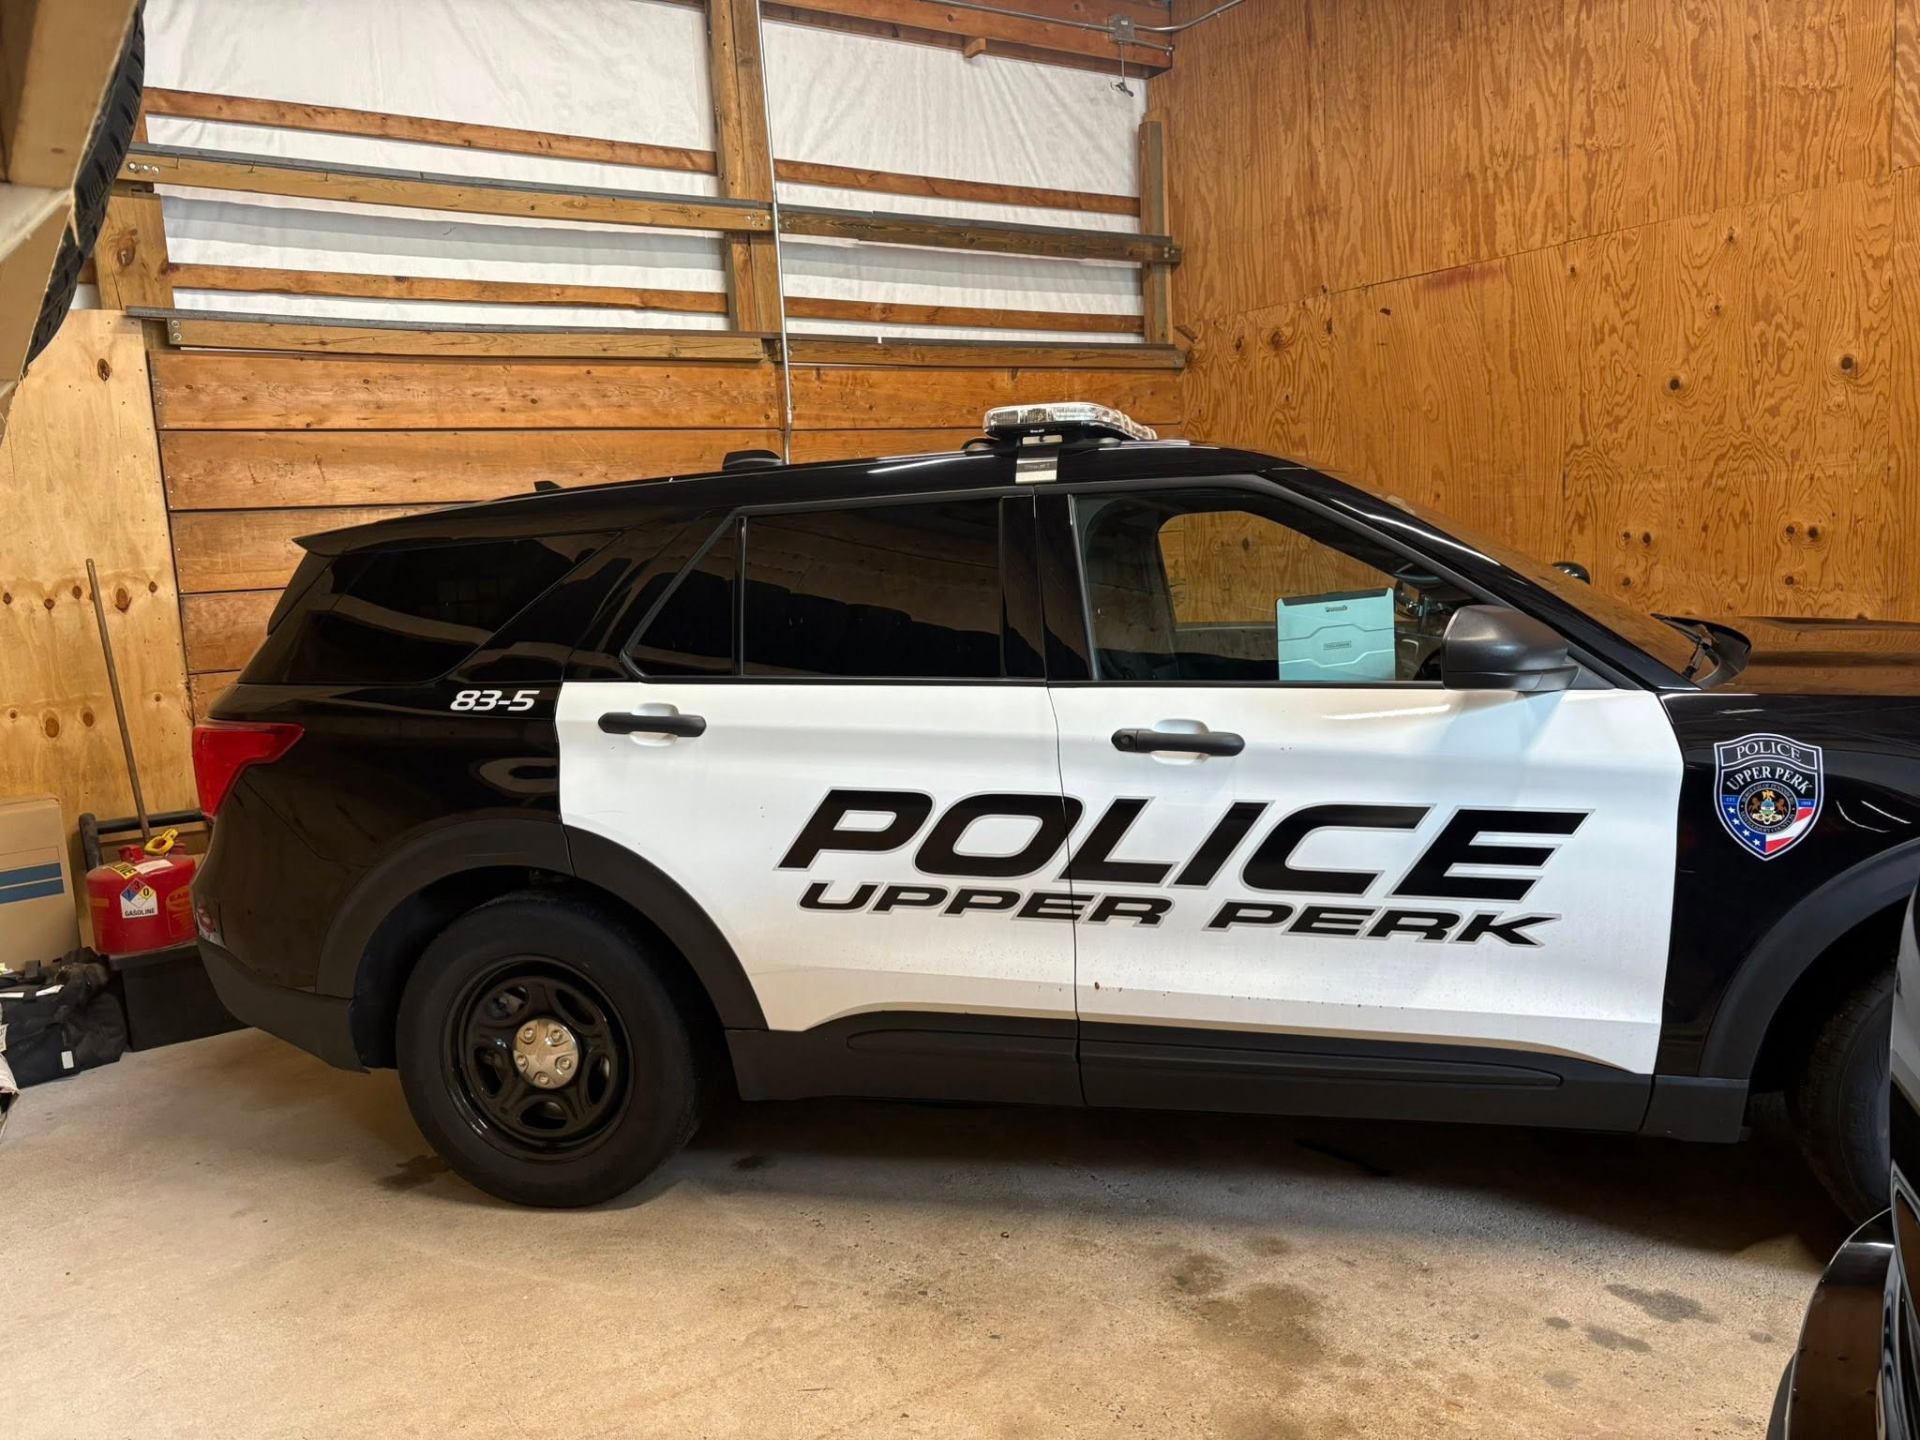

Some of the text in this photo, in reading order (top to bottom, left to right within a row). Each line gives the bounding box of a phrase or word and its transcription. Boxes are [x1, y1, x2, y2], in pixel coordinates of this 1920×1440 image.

[450, 689, 540, 711] 83-5
[1736, 741, 1801, 761] POLICE
[1726, 766, 1772, 790] UPPER
[1775, 768, 1813, 794] PERK
[774, 786, 1596, 903] POLICE
[134, 880, 141, 890] 3
[143, 888, 150, 897] 0
[124, 907, 155, 917] GASOLINE
[797, 880, 1562, 948] UPPER PERK
